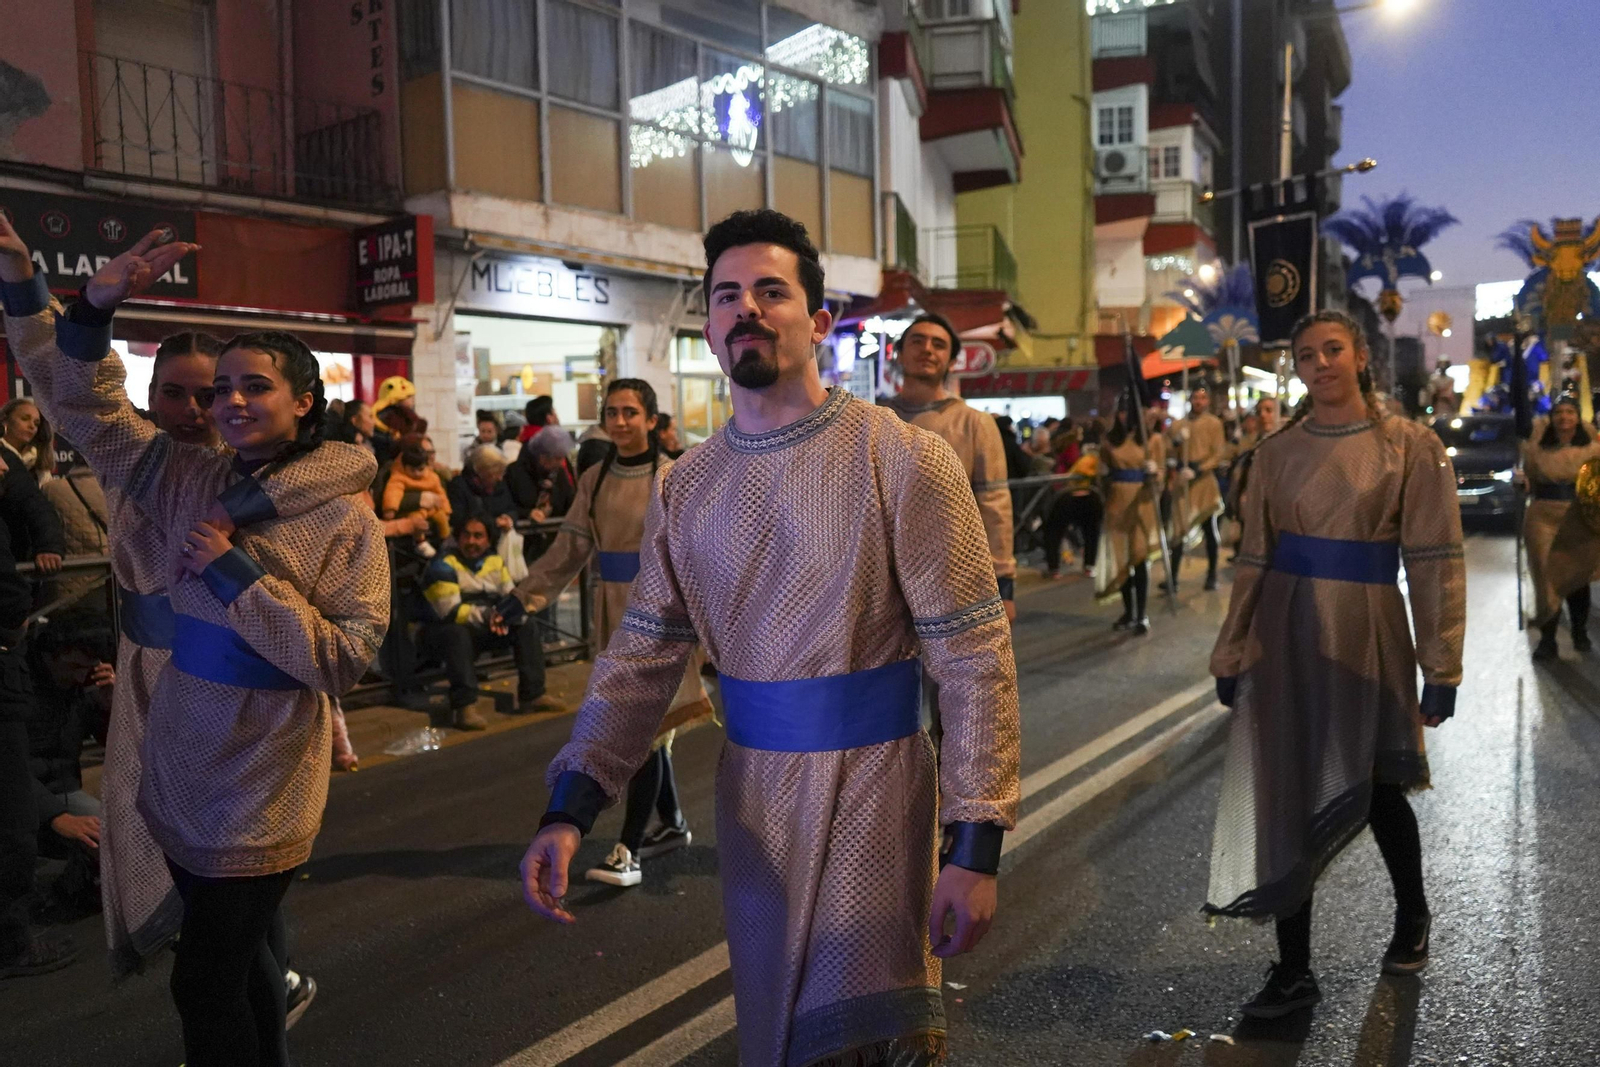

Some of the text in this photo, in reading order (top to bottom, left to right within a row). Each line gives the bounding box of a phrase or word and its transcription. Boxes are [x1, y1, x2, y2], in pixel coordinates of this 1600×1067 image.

[57, 252, 188, 284] LABAL
[373, 265, 401, 284] ROPA
[364, 281, 411, 302] LABORAL
[472, 261, 609, 304] MUEBLES
